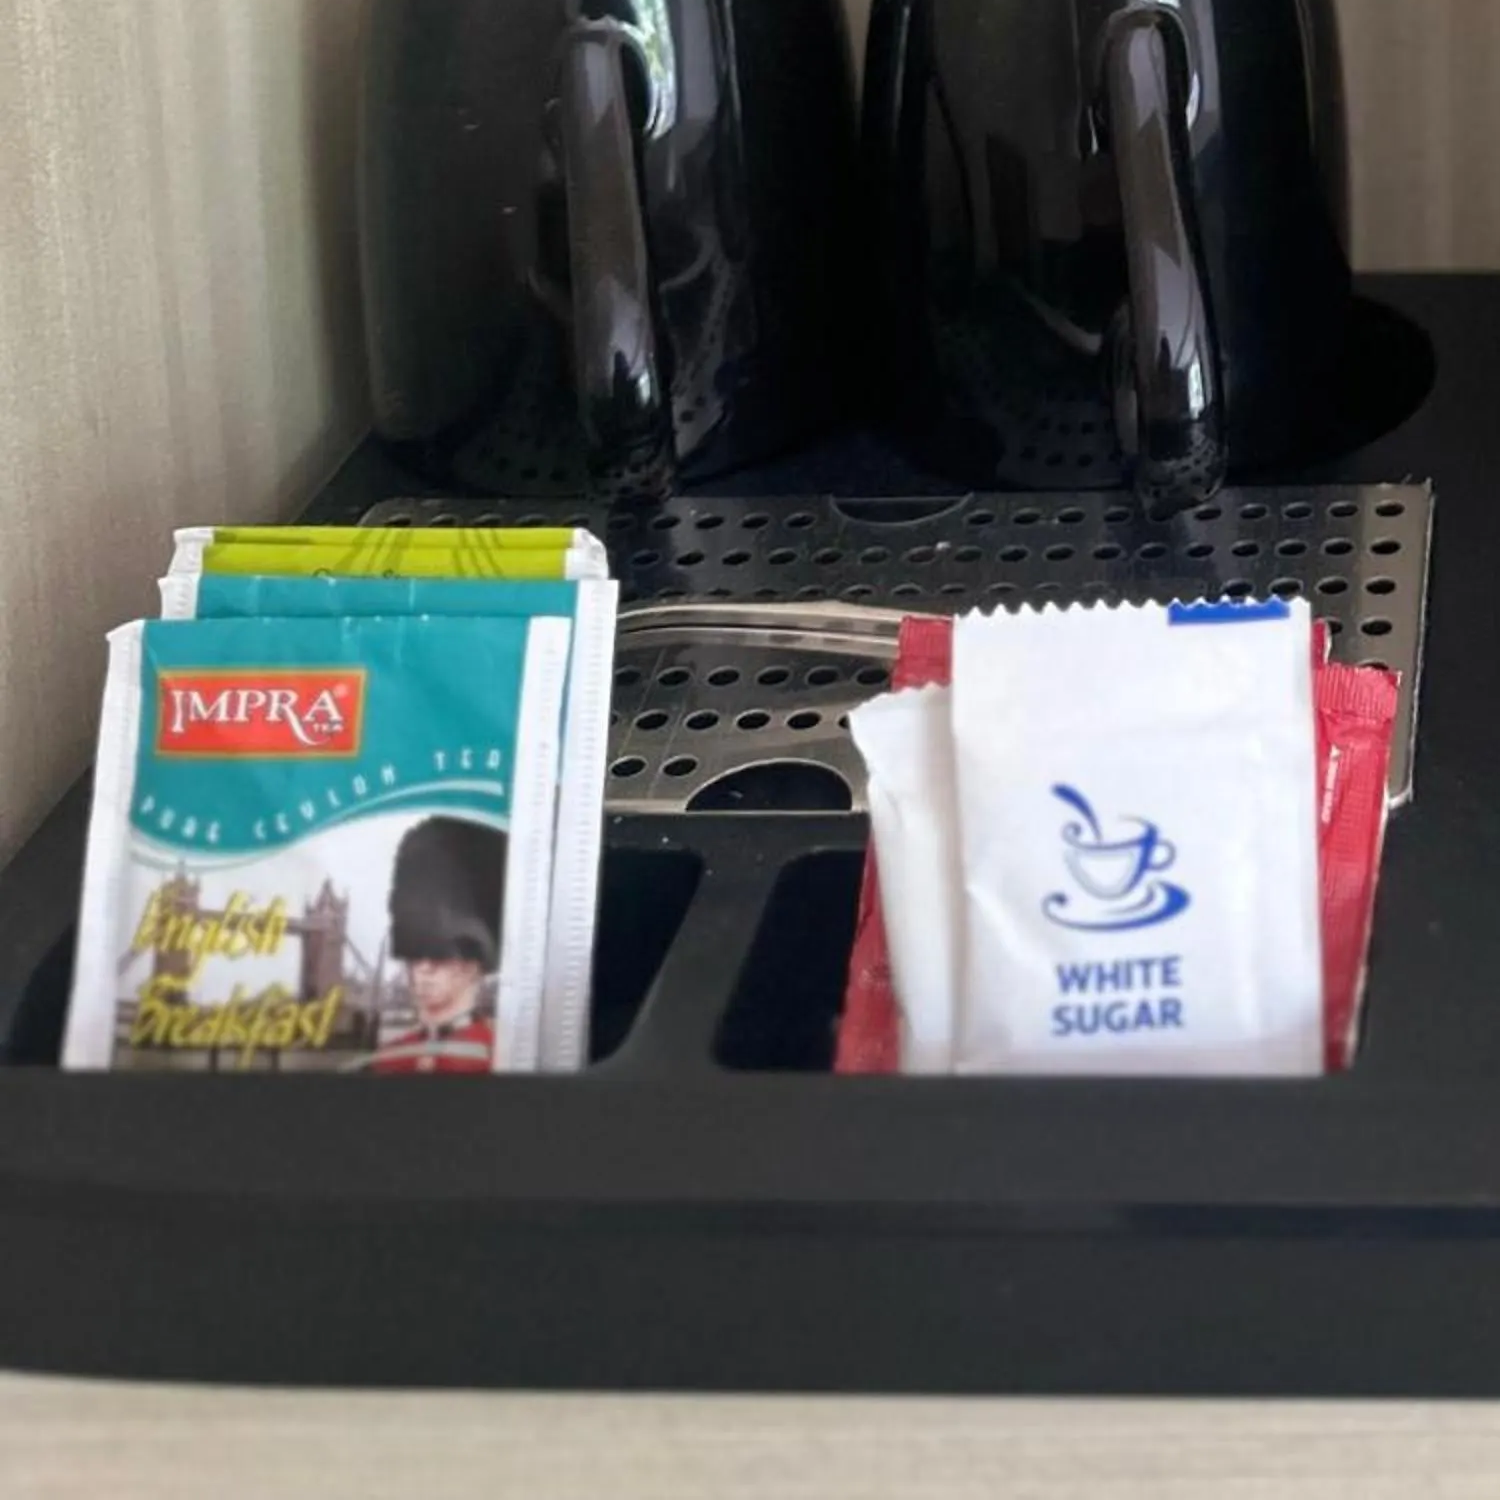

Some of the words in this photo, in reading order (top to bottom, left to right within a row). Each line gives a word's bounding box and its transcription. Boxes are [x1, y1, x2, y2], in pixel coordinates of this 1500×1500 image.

[171, 688, 344, 745] IMPRA
[434, 748, 501, 771] TEA
[131, 888, 288, 988] English
[1055, 955, 1182, 994] WHITE
[129, 978, 343, 1070] Breakfast
[1051, 998, 1183, 1037] SUGAR
